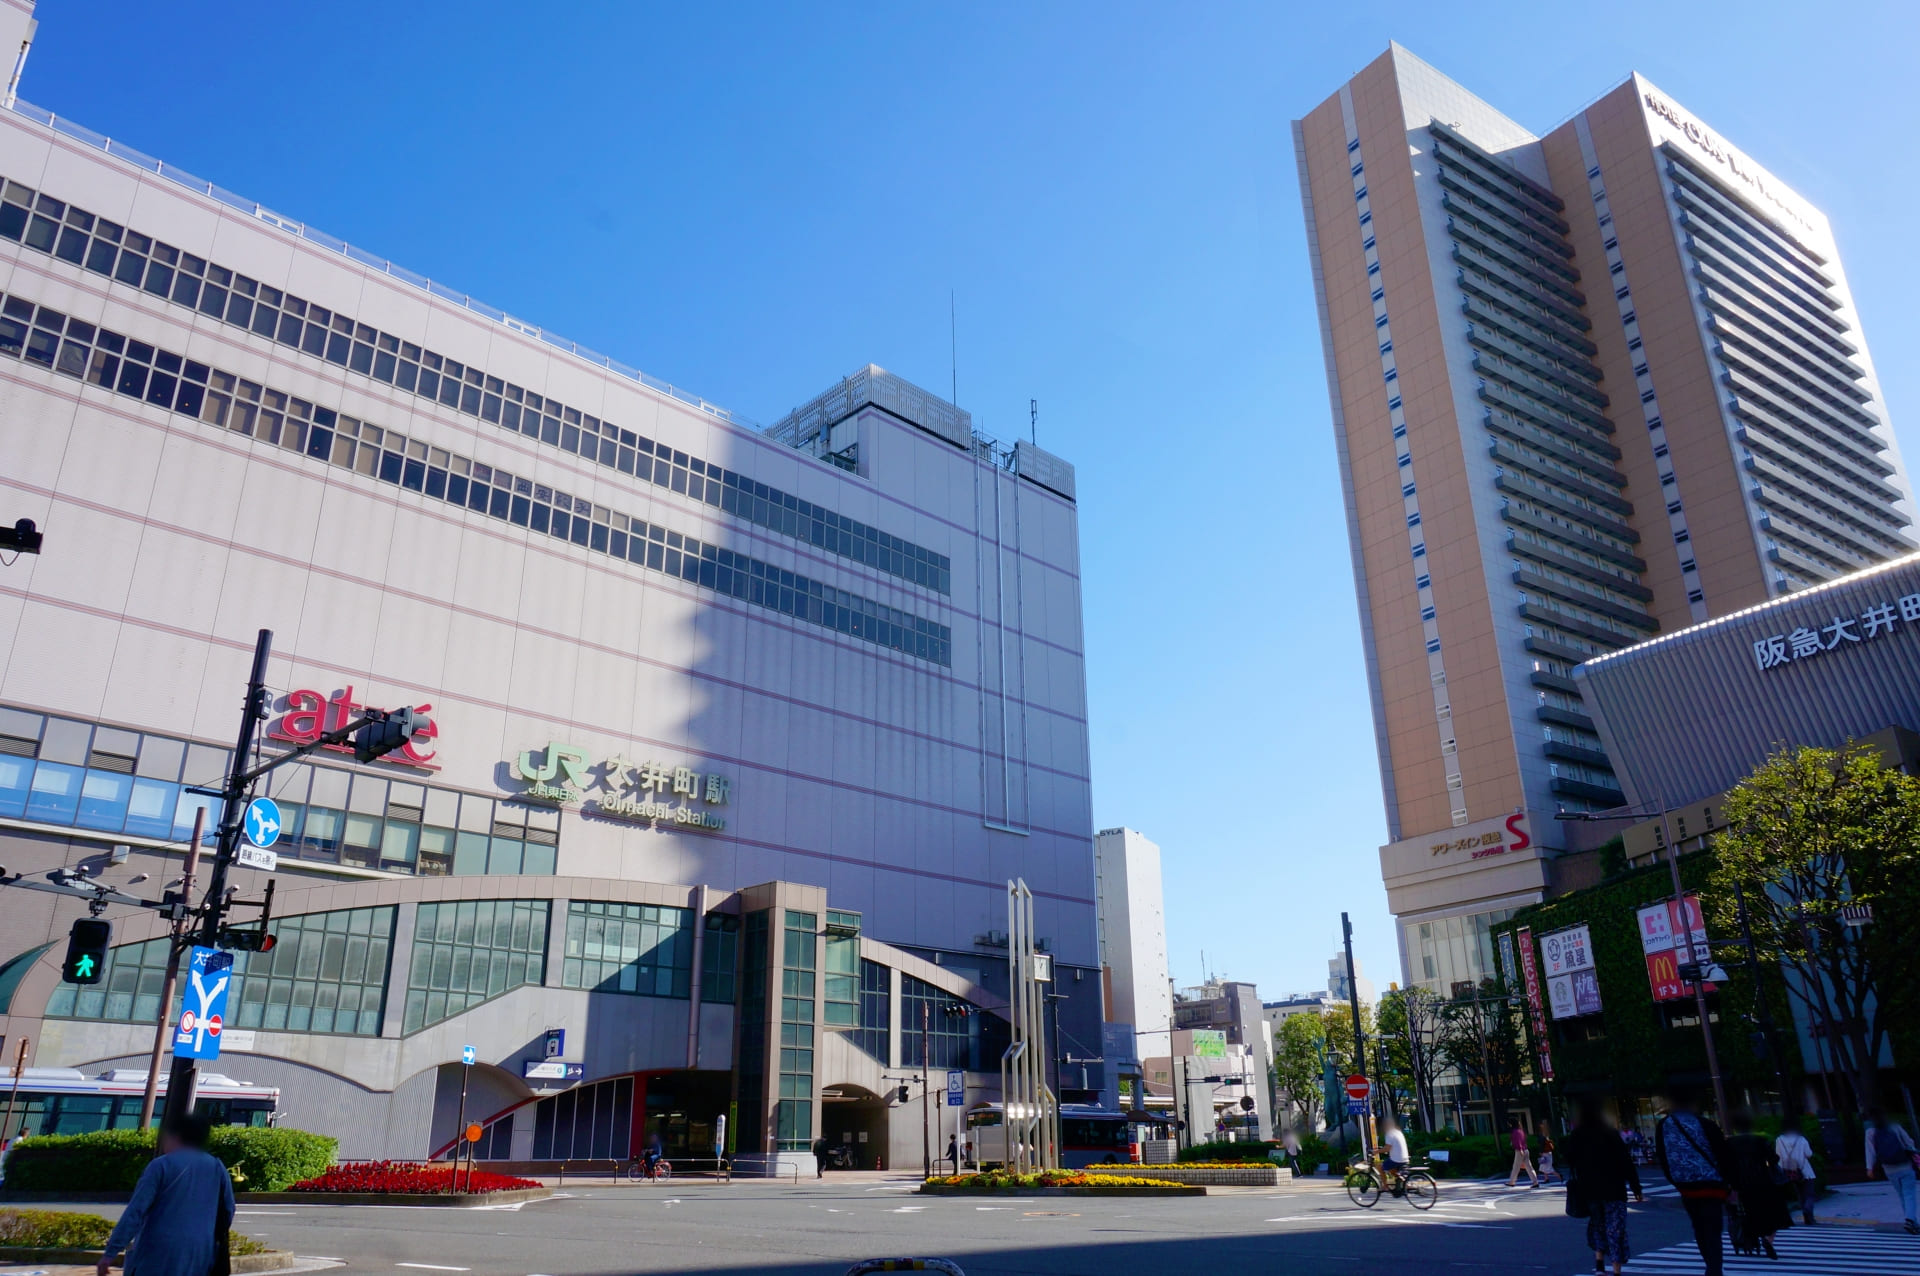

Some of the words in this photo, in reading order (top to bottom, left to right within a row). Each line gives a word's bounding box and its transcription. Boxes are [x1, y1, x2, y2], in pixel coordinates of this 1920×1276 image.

[281, 685, 438, 762] até
[517, 741, 593, 790] JR
[606, 755, 731, 806] 大井町駅
[676, 806, 727, 830] Station
[1506, 813, 1530, 851] S
[193, 950, 231, 972] 大井町駅
[1658, 985, 1668, 997] 1F
